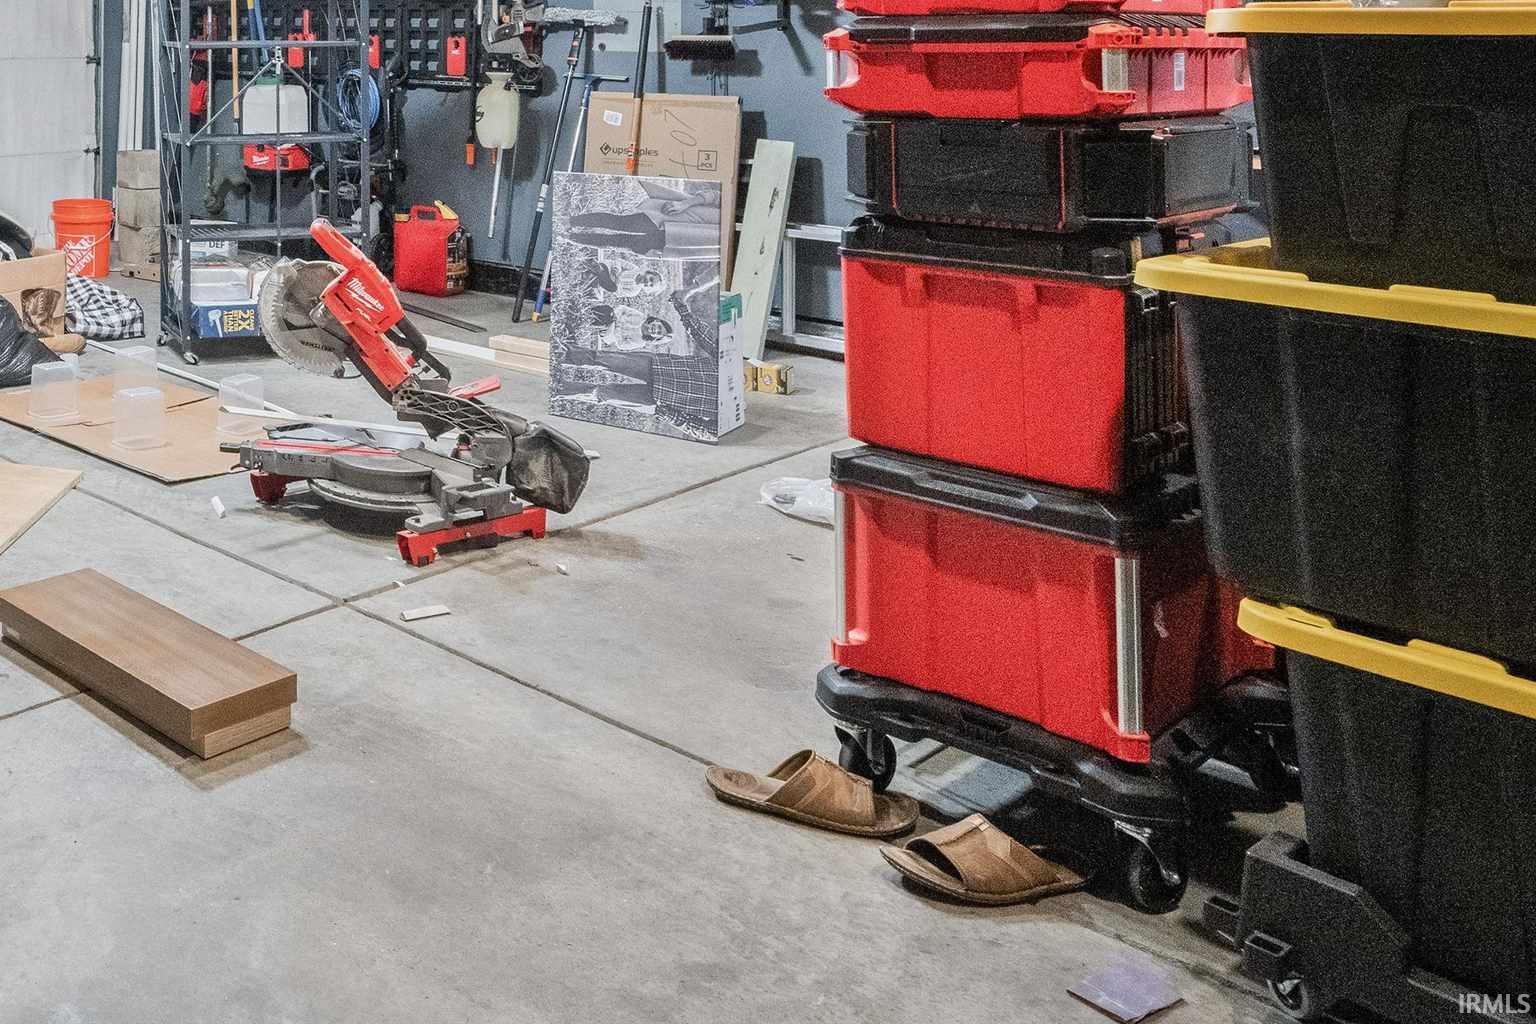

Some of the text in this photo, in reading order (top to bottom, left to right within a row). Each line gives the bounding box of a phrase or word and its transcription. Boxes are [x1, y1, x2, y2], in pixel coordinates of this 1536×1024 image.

[612, 147, 659, 157] upsples
[704, 153, 711, 161] 3
[346, 278, 384, 312] Milwaukee
[238, 309, 250, 331] 2X
